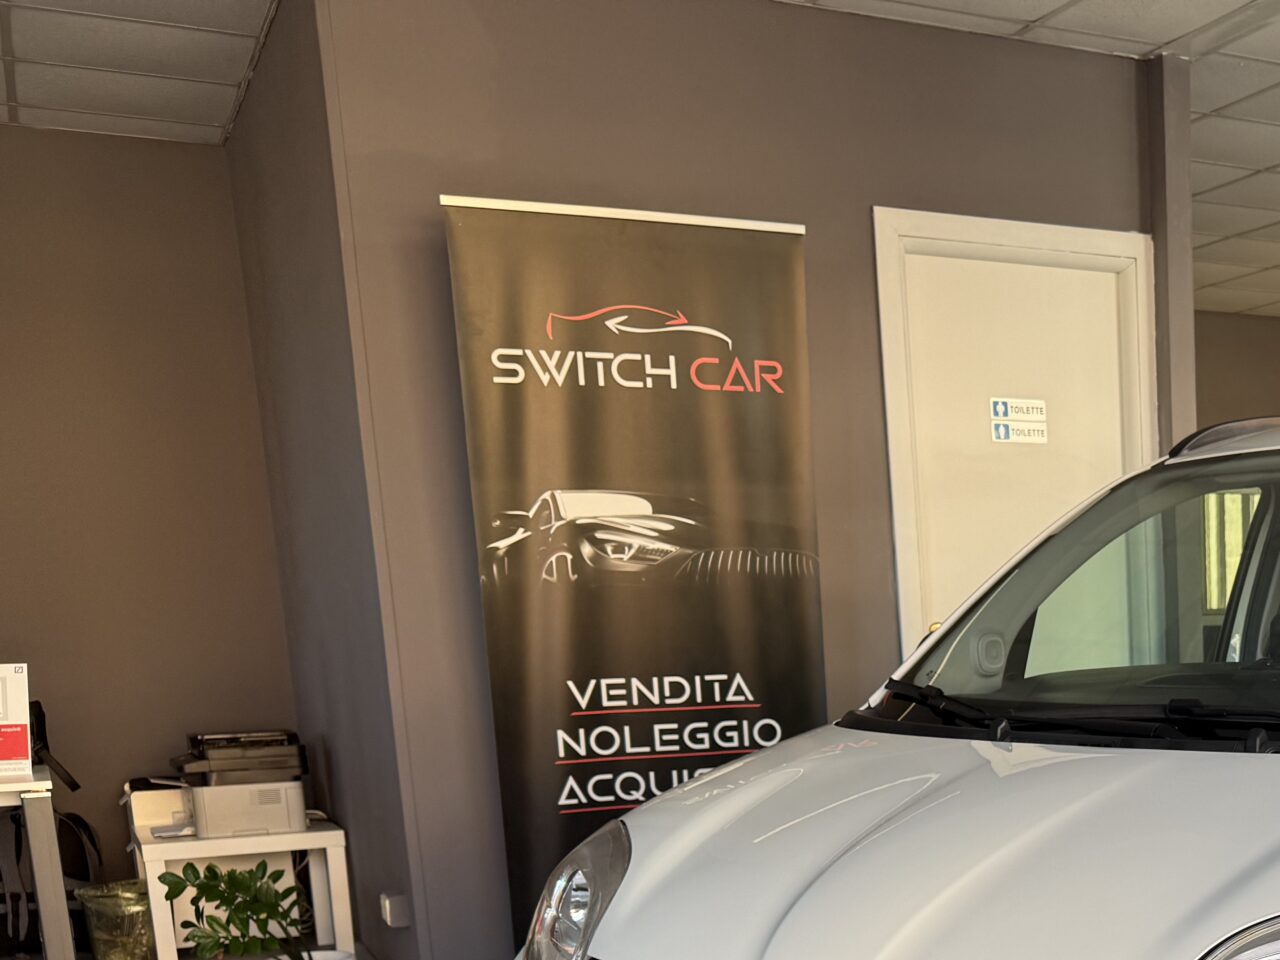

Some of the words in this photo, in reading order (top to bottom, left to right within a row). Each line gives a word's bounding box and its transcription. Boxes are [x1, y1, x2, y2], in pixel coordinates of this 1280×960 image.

[490, 347, 678, 389] SWITCH
[690, 356, 784, 394] CAR
[1010, 405, 1044, 415] TOILETTE
[1012, 428, 1045, 437] TOILETTE
[566, 672, 755, 710] VENDITA
[556, 718, 782, 758] NOLEGGIO
